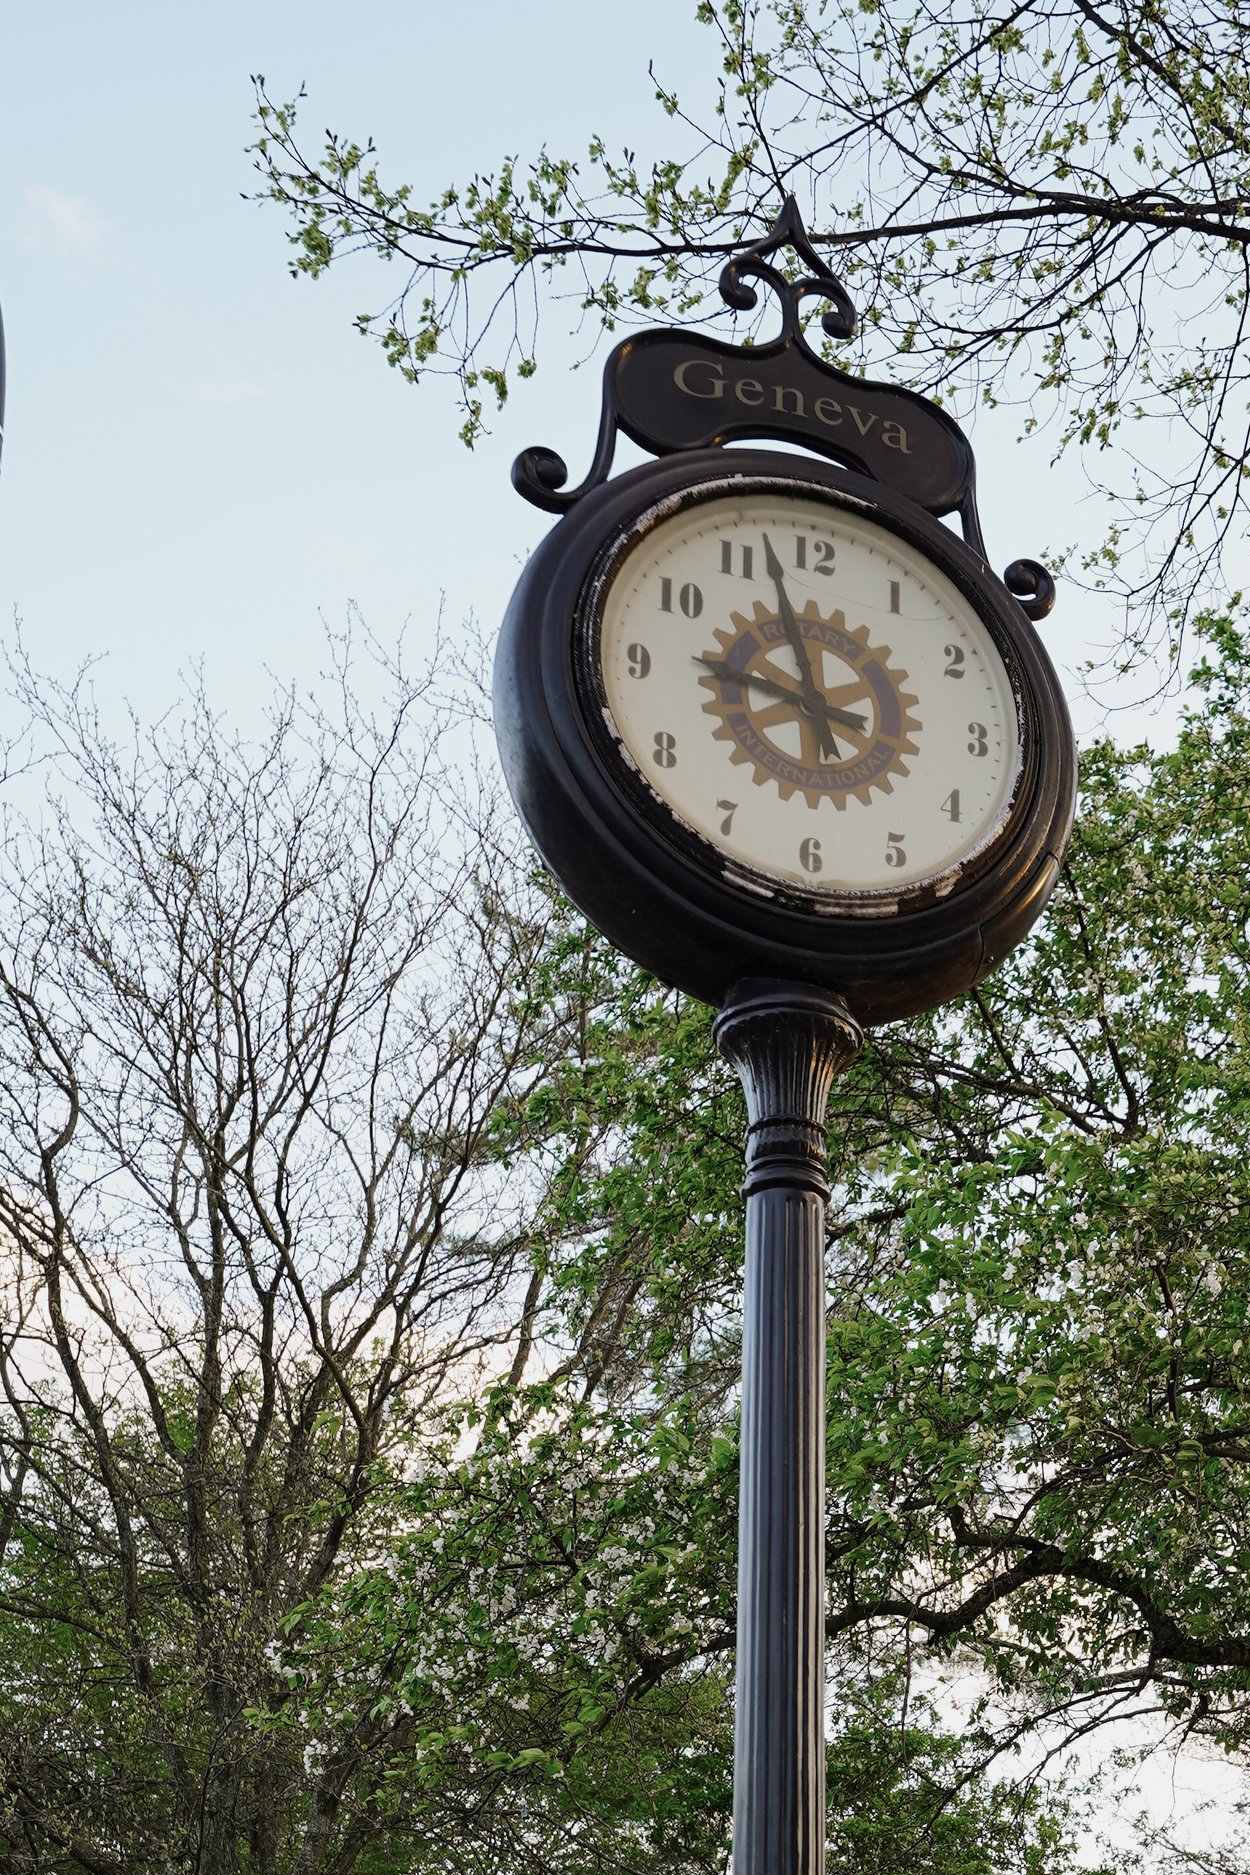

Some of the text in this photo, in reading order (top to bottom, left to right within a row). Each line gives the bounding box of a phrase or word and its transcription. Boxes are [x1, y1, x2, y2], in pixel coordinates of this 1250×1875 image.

[673, 360, 912, 454] Geneva
[718, 539, 756, 581] 11
[793, 535, 836, 576] 12
[657, 576, 703, 619] 10
[887, 579, 903, 616] 1
[627, 643, 651, 680] 9
[944, 644, 965, 679] 2
[653, 731, 677, 768] 8
[736, 725, 889, 787] INTERNATIONAL
[967, 722, 989, 757] 3
[716, 799, 739, 836] 7
[940, 789, 962, 824] 4
[799, 837, 823, 873] 6
[885, 832, 907, 868] 5
